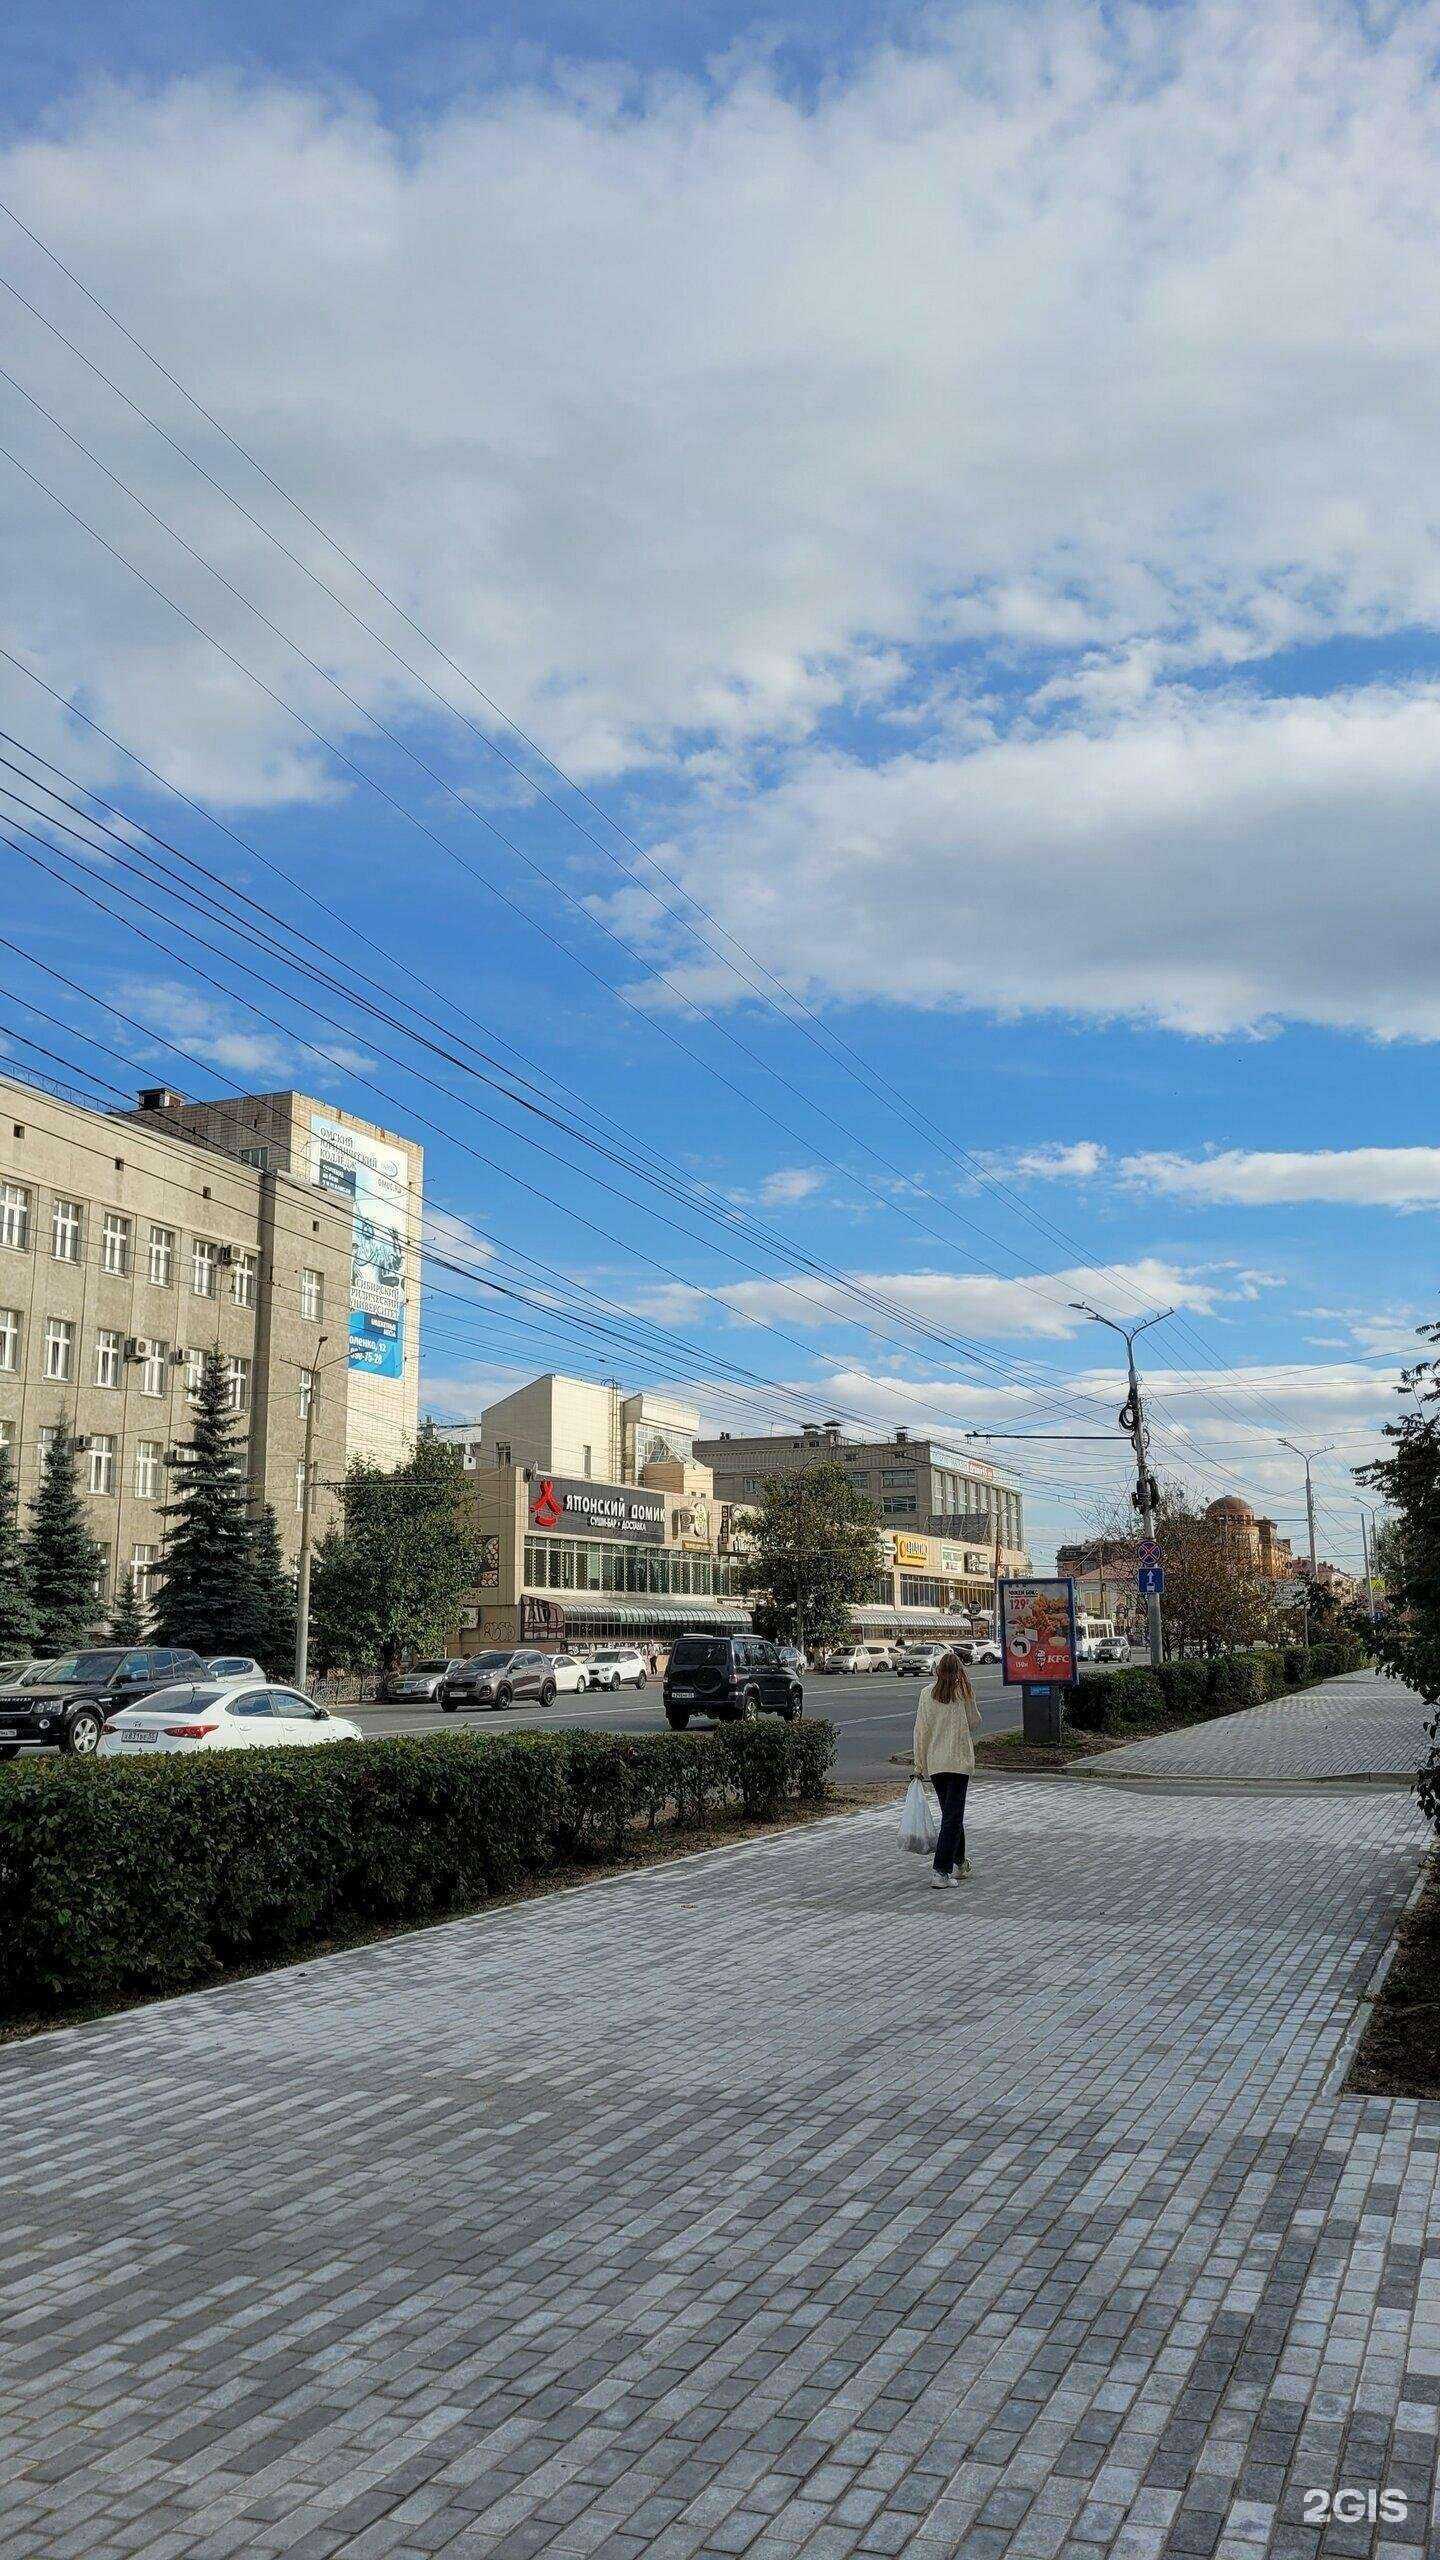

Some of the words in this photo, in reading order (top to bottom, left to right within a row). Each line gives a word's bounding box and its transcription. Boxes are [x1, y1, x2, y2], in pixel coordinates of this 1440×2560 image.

[566, 1494, 626, 1518] ЯПОНСКИЙ
[631, 1504, 666, 1522] ДОМИК
[1047, 1654, 1070, 1664] KFC
